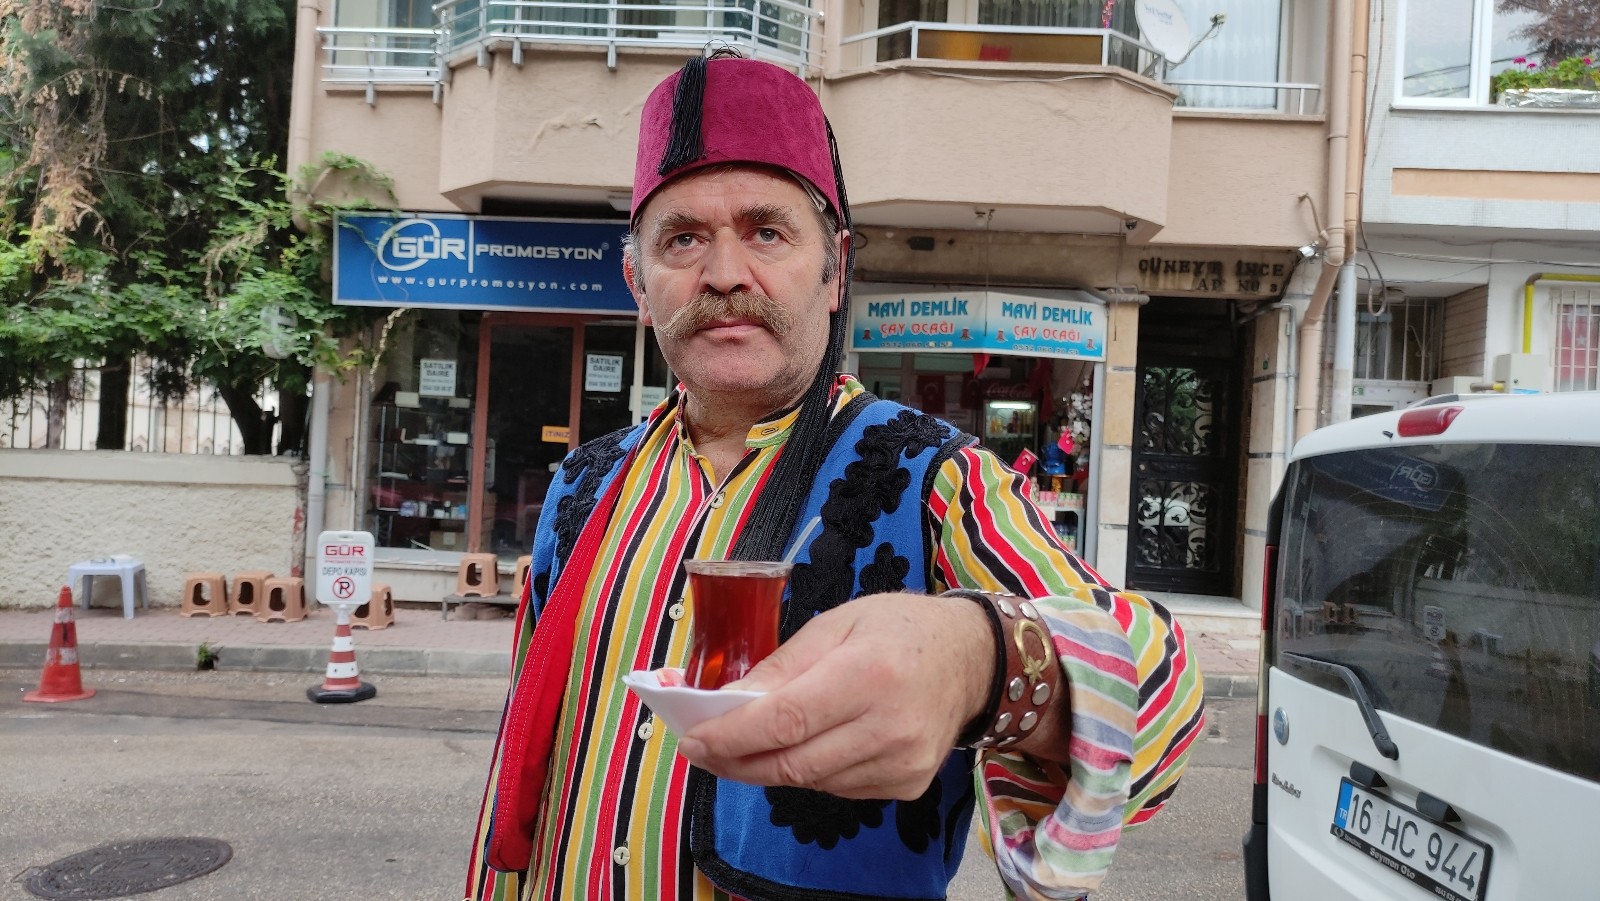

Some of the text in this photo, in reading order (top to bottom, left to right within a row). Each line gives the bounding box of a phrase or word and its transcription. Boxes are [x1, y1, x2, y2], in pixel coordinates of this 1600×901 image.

[392, 235, 603, 261] GÜR PROMOSYON
[377, 275, 602, 292] www.gurpromosyon.com
[868, 298, 968, 317] MAVİ DEMLİK
[1002, 301, 1093, 326] MAVİ DEMLİK
[880, 321, 955, 337] ÇAY OCAĞI
[1013, 325, 1081, 342] ÇAY OCAĞI
[1339, 808, 1348, 820] TR
[1351, 794, 1477, 891] 16 HC 944
